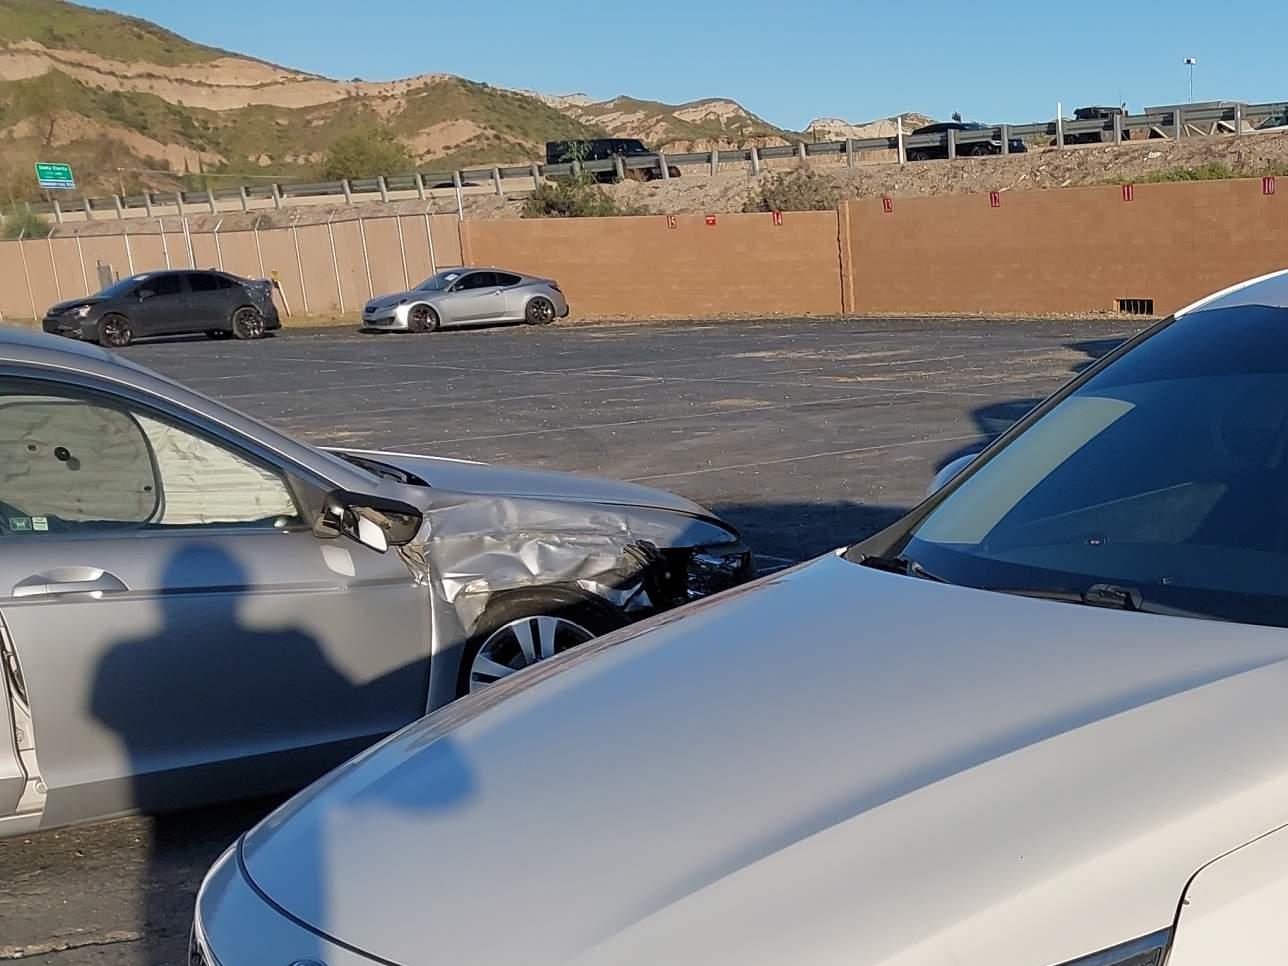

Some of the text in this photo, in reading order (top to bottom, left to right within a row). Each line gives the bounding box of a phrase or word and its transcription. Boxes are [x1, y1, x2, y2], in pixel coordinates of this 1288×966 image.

[1124, 185, 1133, 200] 11
[1264, 178, 1274, 194] 10
[884, 199, 893, 211] 13
[991, 193, 1000, 206] 12
[668, 216, 676, 228] 15
[773, 211, 782, 225] 14
